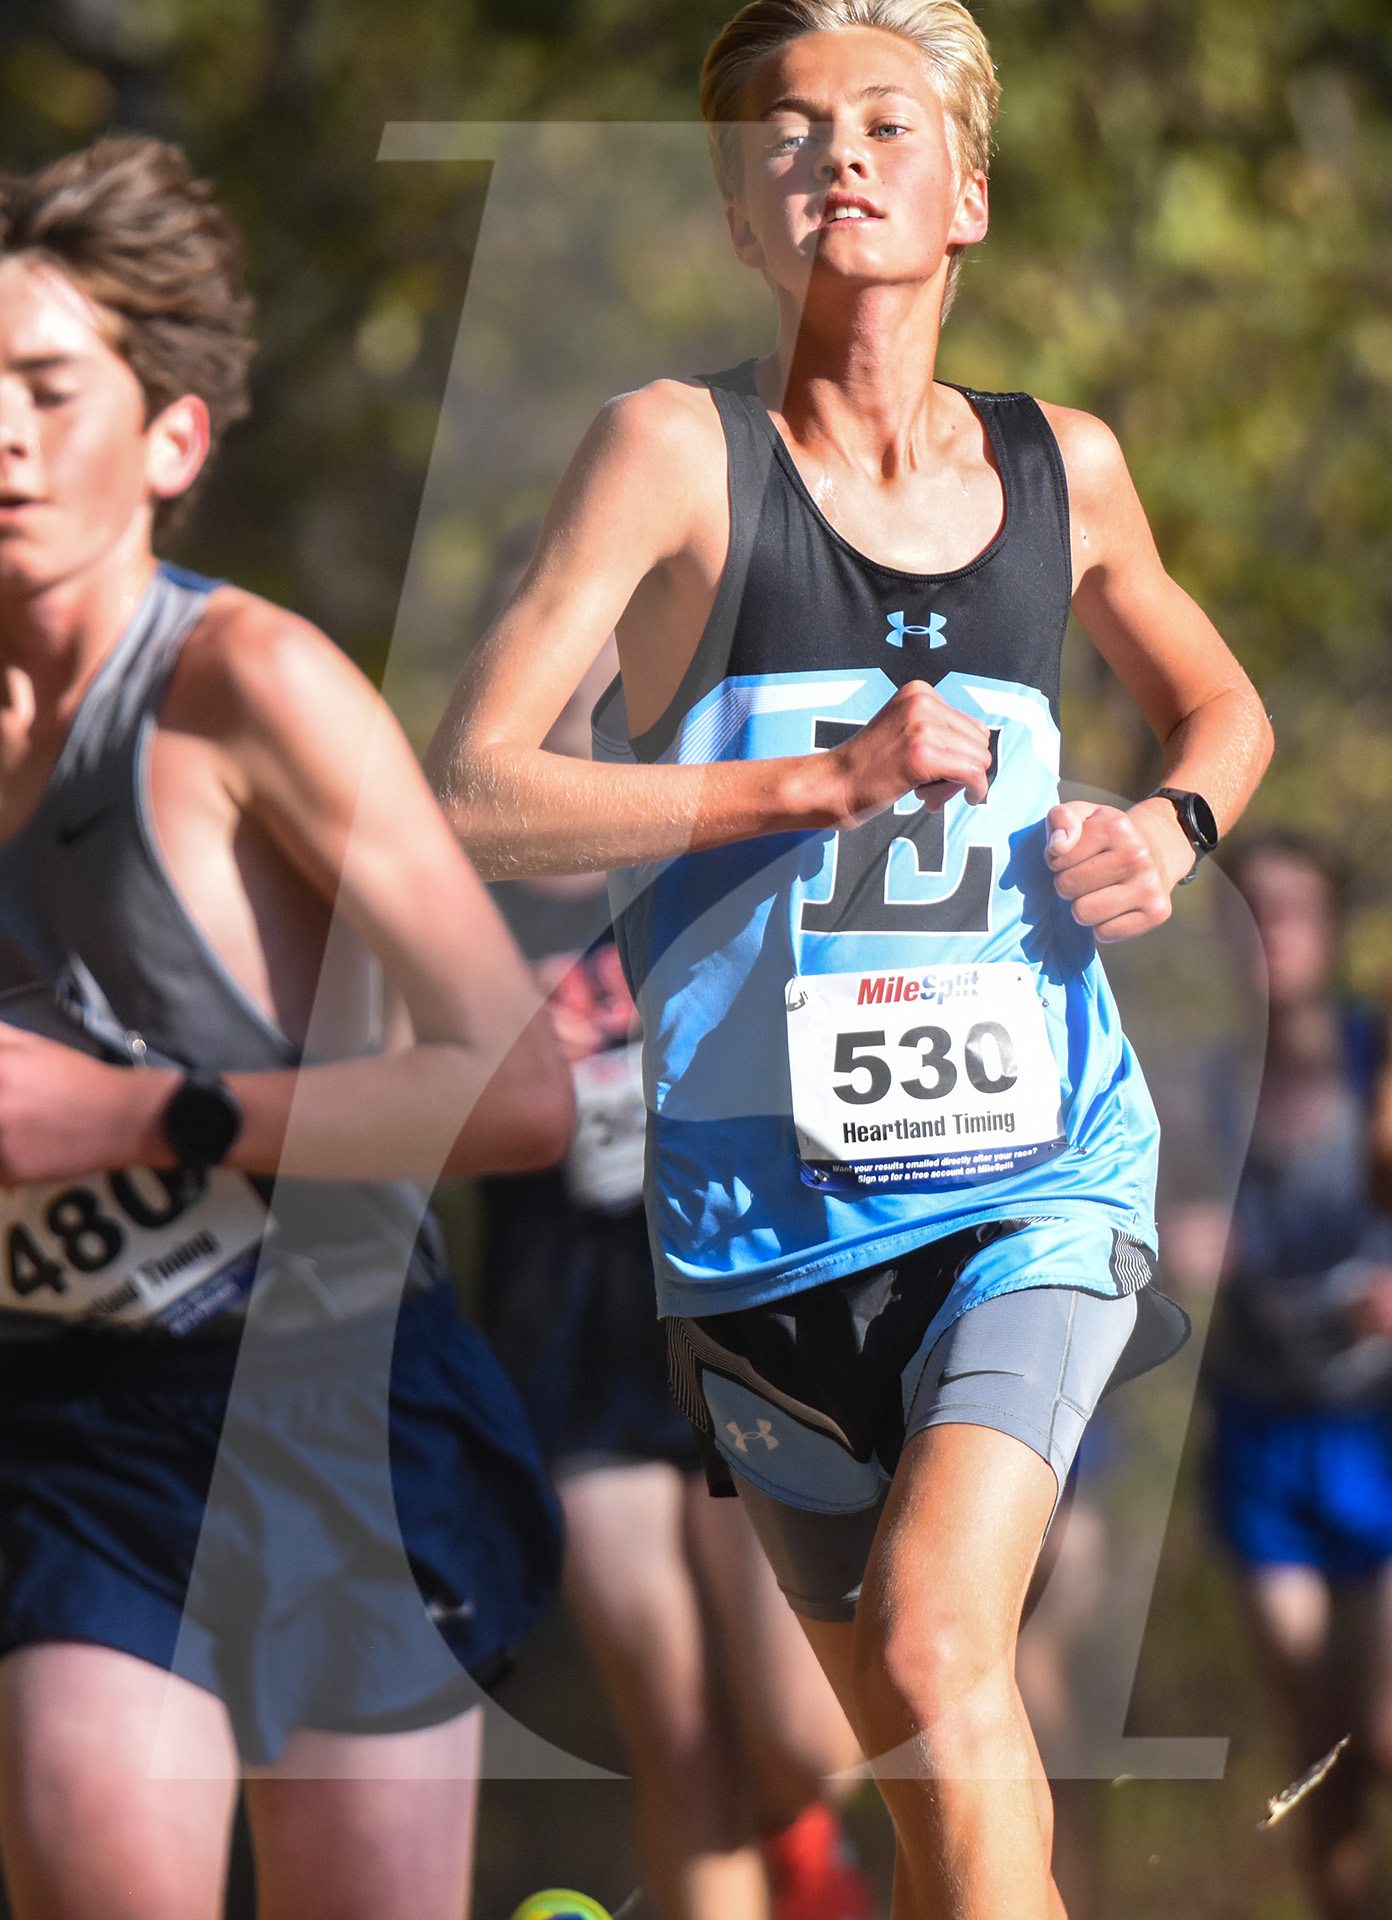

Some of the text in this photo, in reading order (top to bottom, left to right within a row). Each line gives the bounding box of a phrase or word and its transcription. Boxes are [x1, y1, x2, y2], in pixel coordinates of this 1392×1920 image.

[800, 718, 1003, 933] E
[857, 971, 979, 1005] MileSplit
[832, 1021, 1018, 1105] 530
[842, 1111, 1016, 1144] Heartland Timing
[854, 1164, 873, 1174] your
[874, 1161, 904, 1171] results
[905, 1158, 940, 1169] emailed
[940, 1155, 972, 1166] directly
[972, 1153, 993, 1164] after
[993, 1151, 1013, 1162] your
[1013, 1146, 1038, 1158] race?
[858, 1174, 877, 1185] Sign
[877, 1174, 890, 1183] up
[890, 1172, 904, 1181] for
[911, 1170, 930, 1179] free
[930, 1166, 965, 1178] account
[964, 1166, 977, 1175] on
[977, 1161, 1014, 1174] MileSplit
